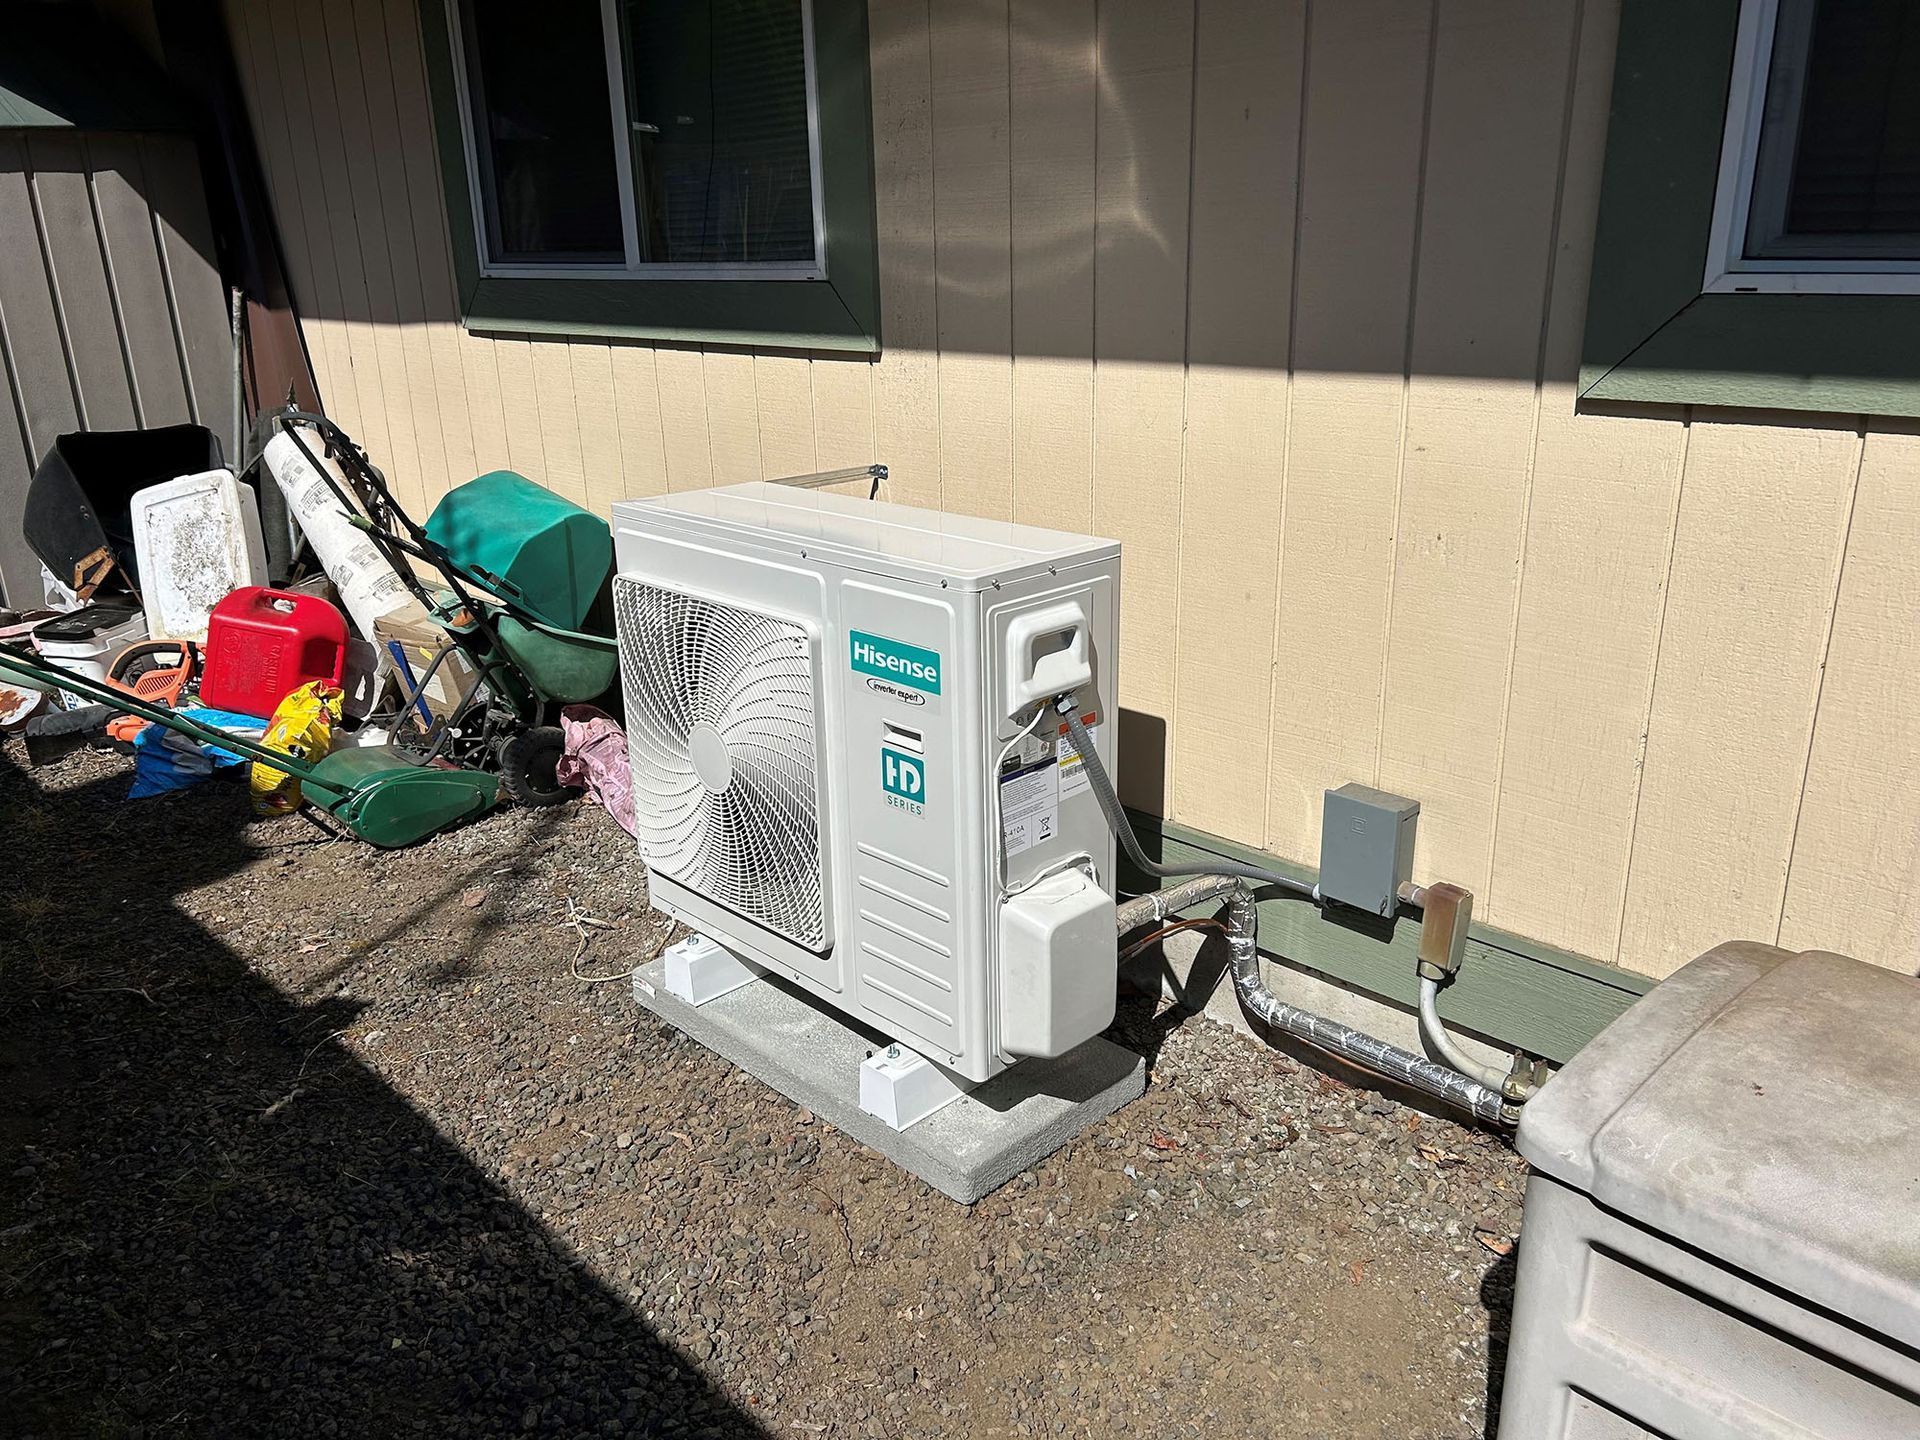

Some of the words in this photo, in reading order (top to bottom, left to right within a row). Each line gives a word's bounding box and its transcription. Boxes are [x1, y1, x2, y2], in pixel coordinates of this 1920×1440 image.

[854, 641, 937, 682] Hisense
[873, 681, 897, 696] inverter
[897, 690, 919, 703] expert
[887, 795, 922, 815] SERIES
